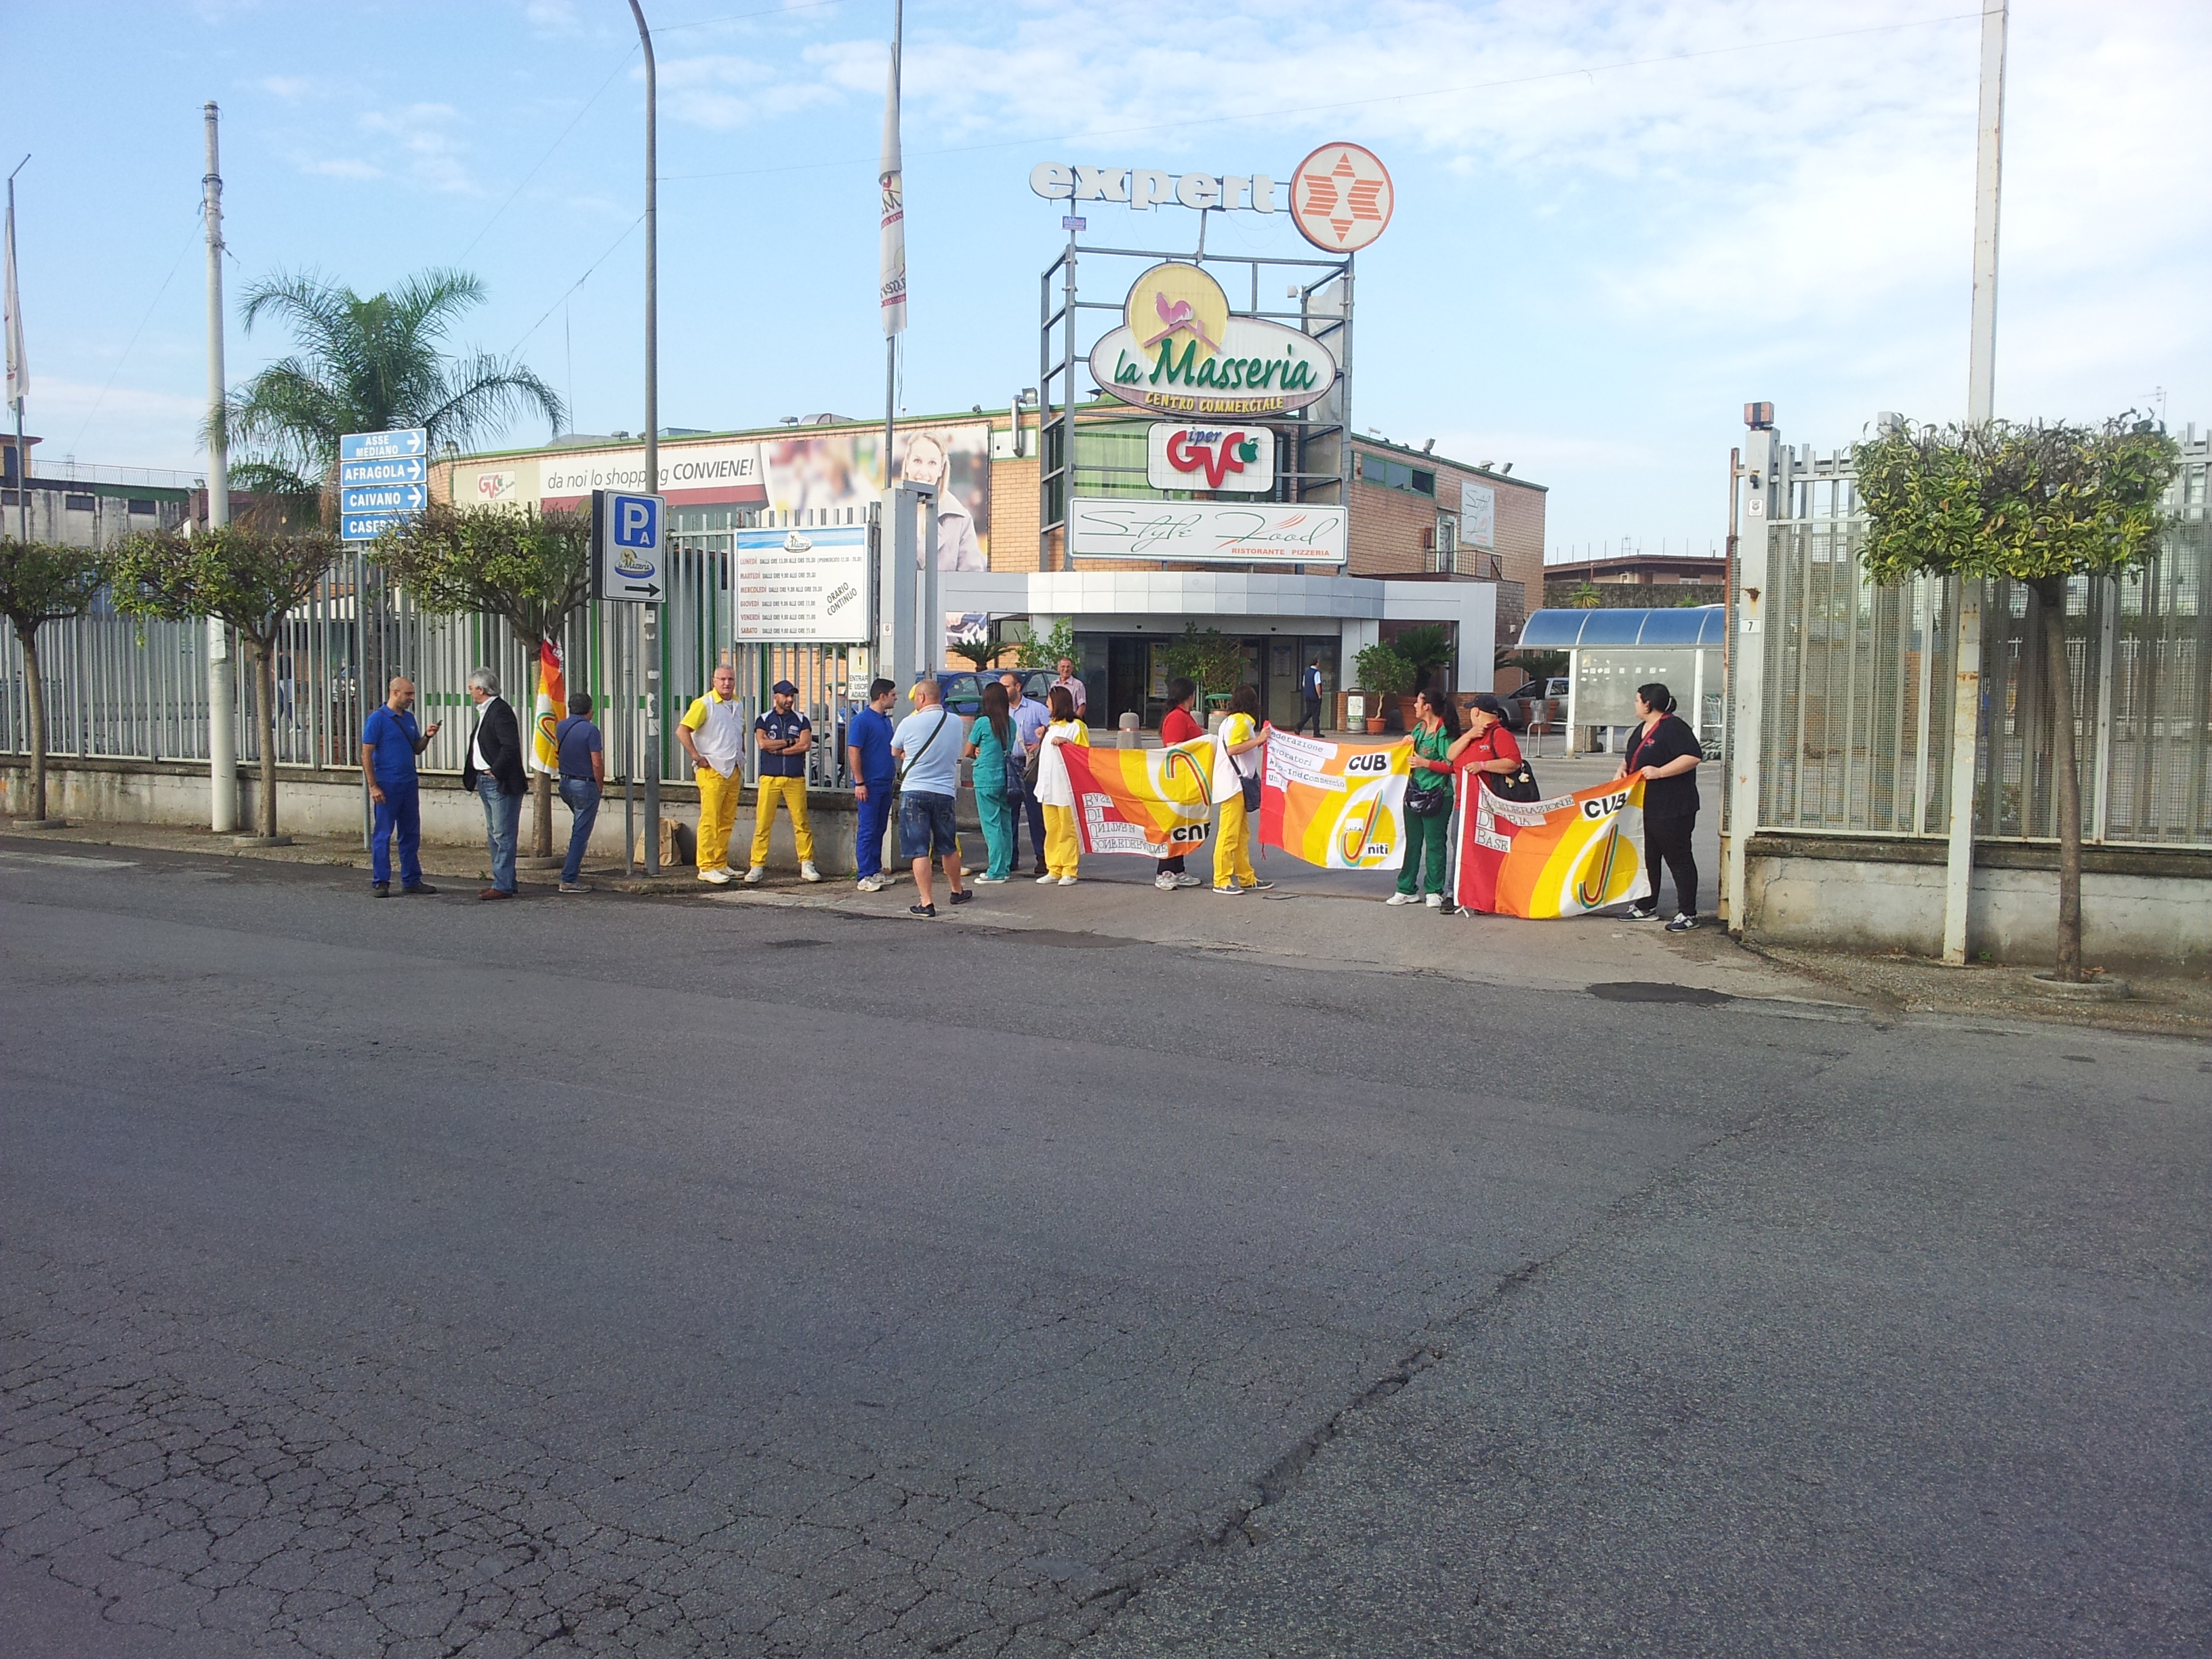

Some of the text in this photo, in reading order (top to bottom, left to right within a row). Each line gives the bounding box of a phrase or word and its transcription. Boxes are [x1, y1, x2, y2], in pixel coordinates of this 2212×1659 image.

[1029, 161, 1275, 213] expert
[1114, 338, 1317, 390] la Masseria
[1145, 392, 1284, 413] CENTRO COMMERCIALE
[366, 435, 389, 446] ASSE
[1187, 426, 1223, 446] iper
[356, 445, 398, 457] MEDIANO
[1167, 430, 1244, 488] GVC
[345, 465, 405, 480] AFRAGOLA
[548, 459, 754, 489] da noi lo shoppg CONVIENE!
[350, 492, 401, 507] CAIVANO
[623, 502, 651, 545] P A
[1078, 510, 1202, 553] Style
[1231, 548, 1285, 556] RISTORANTE
[827, 582, 848, 603] ORARIO
[827, 588, 857, 615] CONTINUO
[1748, 621, 1753, 631] 7
[1271, 731, 1323, 753] ederazione
[1349, 754, 1387, 771] CUB
[1584, 792, 1626, 819] CUB
[1368, 844, 1389, 855] niti
[1477, 828, 1509, 851] BASE
